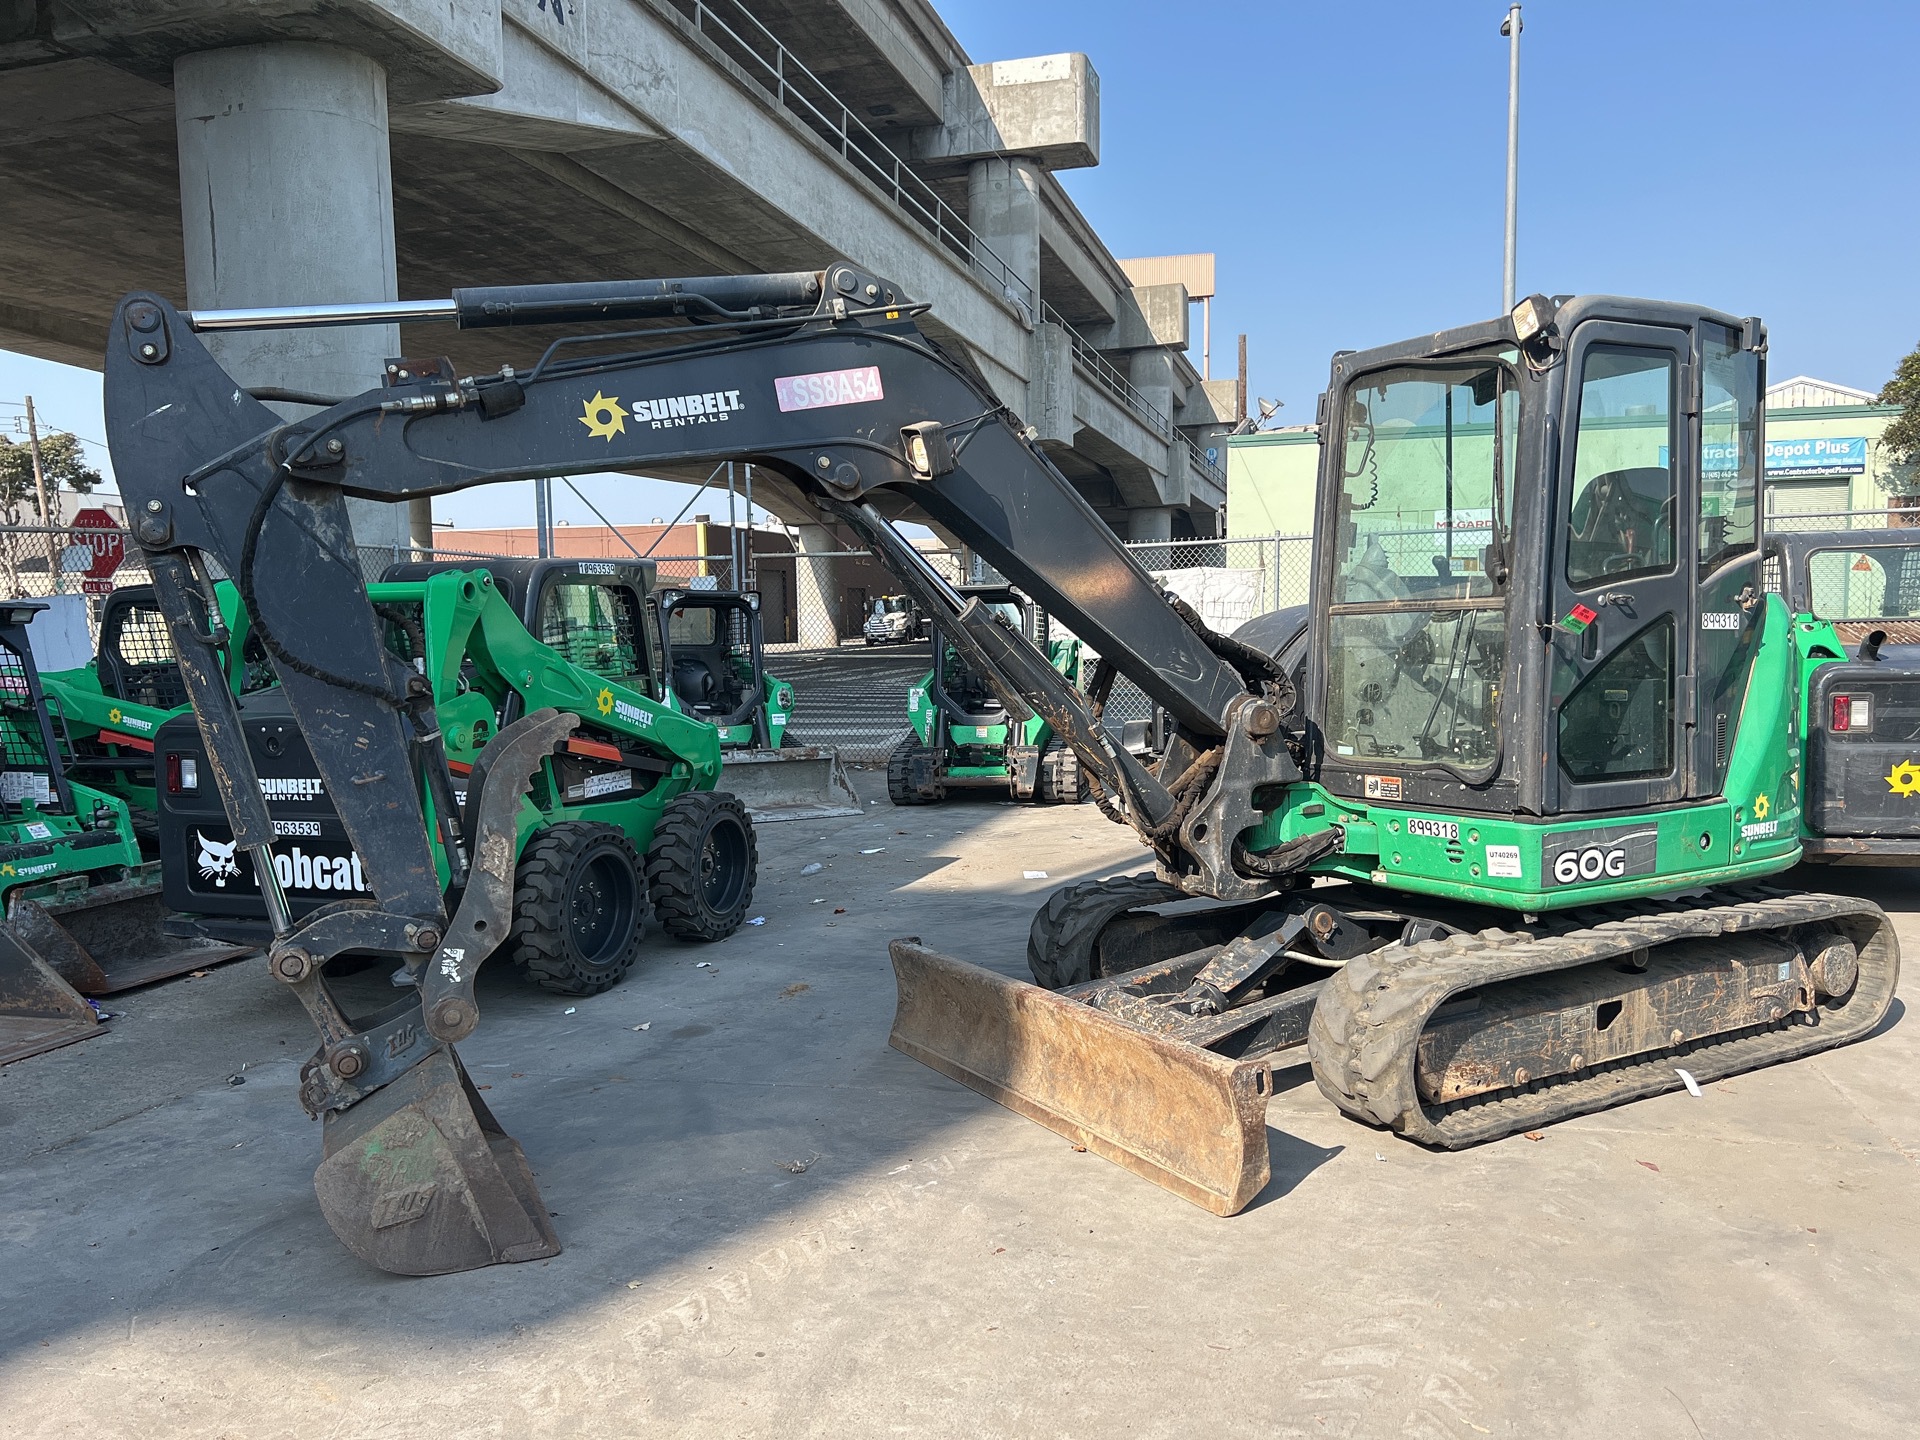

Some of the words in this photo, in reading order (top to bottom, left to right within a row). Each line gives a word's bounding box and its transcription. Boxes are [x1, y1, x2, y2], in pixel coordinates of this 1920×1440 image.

[792, 369, 879, 407] SS8A54
[632, 390, 741, 422] SUNBELT
[651, 412, 729, 430] RENTALS
[1765, 442, 1810, 459] Depot
[1815, 441, 1850, 455] Plus
[1702, 614, 1739, 628] 899318
[614, 700, 653, 726] SUNBELT
[619, 714, 647, 729] RENTALS
[122, 716, 152, 729] SUNBELT
[258, 779, 322, 794] SUNBELT
[1409, 820, 1458, 839] 899318
[1741, 820, 1778, 837] SUNBELT
[255, 847, 364, 891] obcat
[1553, 847, 1625, 884] 60G
